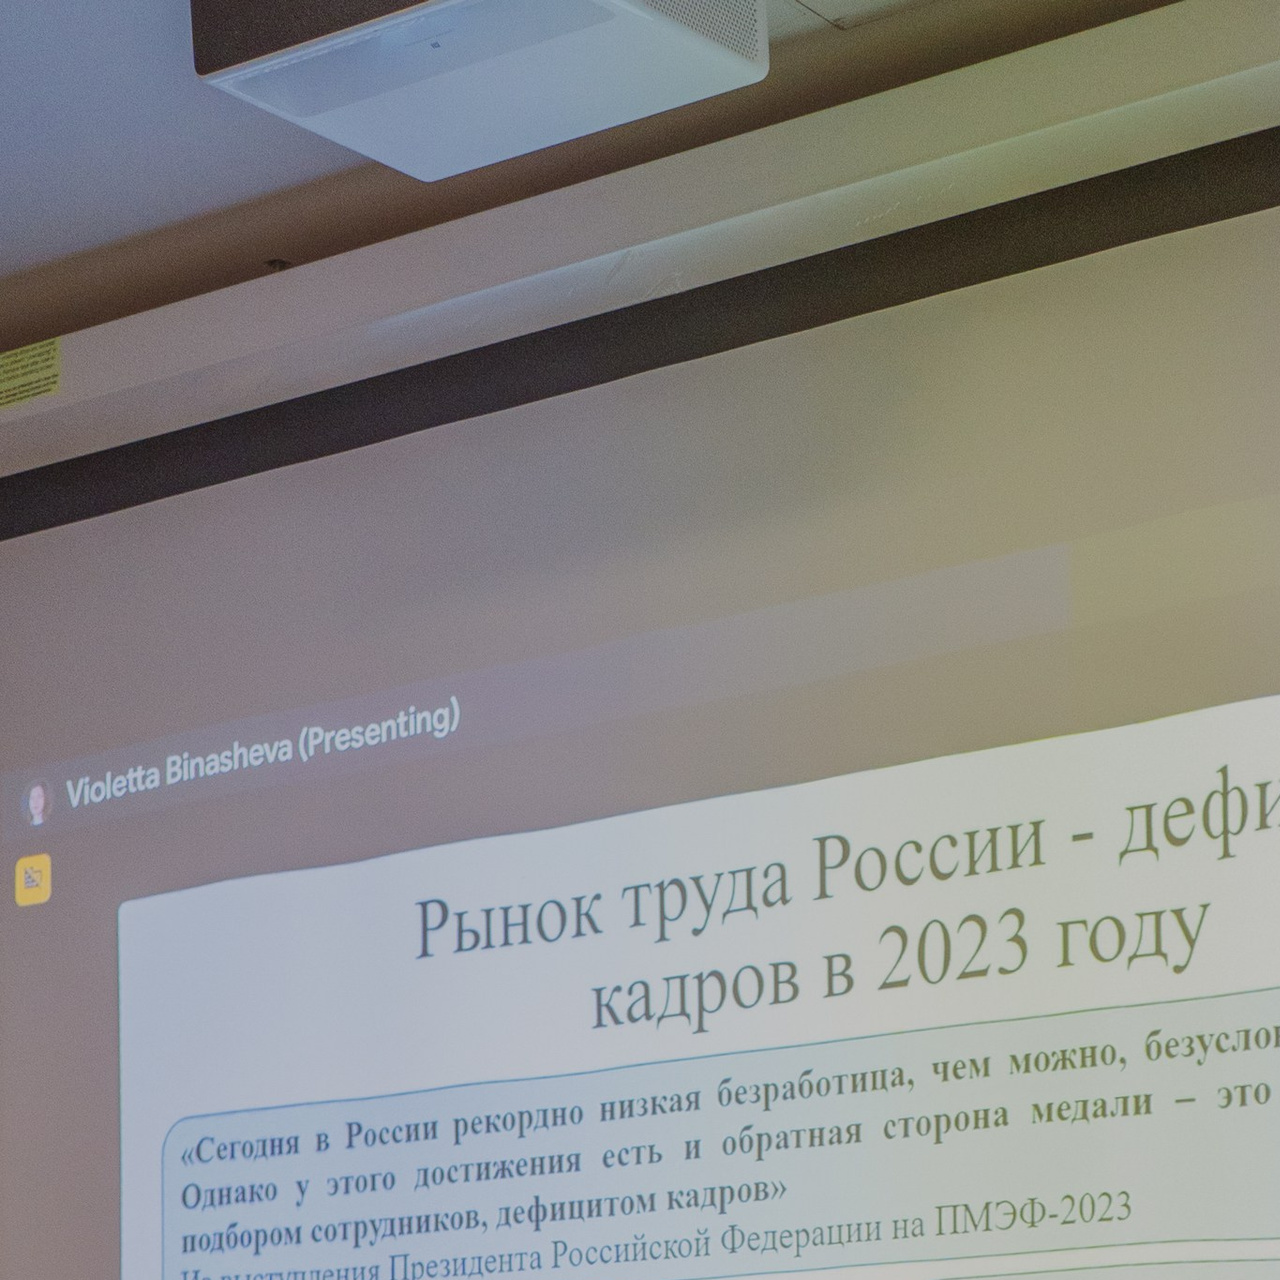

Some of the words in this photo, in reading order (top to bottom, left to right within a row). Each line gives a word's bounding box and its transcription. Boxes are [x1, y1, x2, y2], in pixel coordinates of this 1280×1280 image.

[65, 764, 161, 808] Violetta
[165, 738, 294, 786] Binasheva
[298, 694, 461, 763] (Presenting)
[414, 892, 604, 961] Рынок
[620, 861, 793, 944] труда
[812, 818, 1046, 902] России
[590, 960, 801, 1035] кадров
[822, 952, 855, 999] в
[877, 906, 1029, 992] 2023
[1056, 901, 1212, 975] году
[180, 1134, 300, 1166] «Сегодня
[315, 1131, 331, 1153] в
[345, 1119, 439, 1150] России
[452, 1104, 585, 1146] рекордно
[599, 1090, 702, 1123] низкая
[716, 1066, 915, 1112] безработица,
[931, 1055, 991, 1083] чем
[1009, 1043, 1128, 1076] можно,
[180, 1182, 279, 1211] Однако
[295, 1179, 310, 1208] у
[326, 1171, 397, 1197] этого
[413, 1152, 582, 1191] достижения
[601, 1143, 664, 1169] есть
[684, 1138, 702, 1161] и
[721, 1122, 863, 1162] обратная
[882, 1106, 1010, 1146] сторона
[1031, 1093, 1153, 1125] медали
[1217, 1082, 1272, 1110] это
[181, 1221, 303, 1257] подбором
[310, 1209, 489, 1250] сотрудников,
[495, 1192, 657, 1233] дефицитом
[666, 1180, 788, 1216] кадров»
[551, 1228, 711, 1270] Российской
[720, 1220, 882, 1259] Федерации
[891, 1216, 926, 1241] на
[934, 1189, 1132, 1237] ПМЭФ-2023
